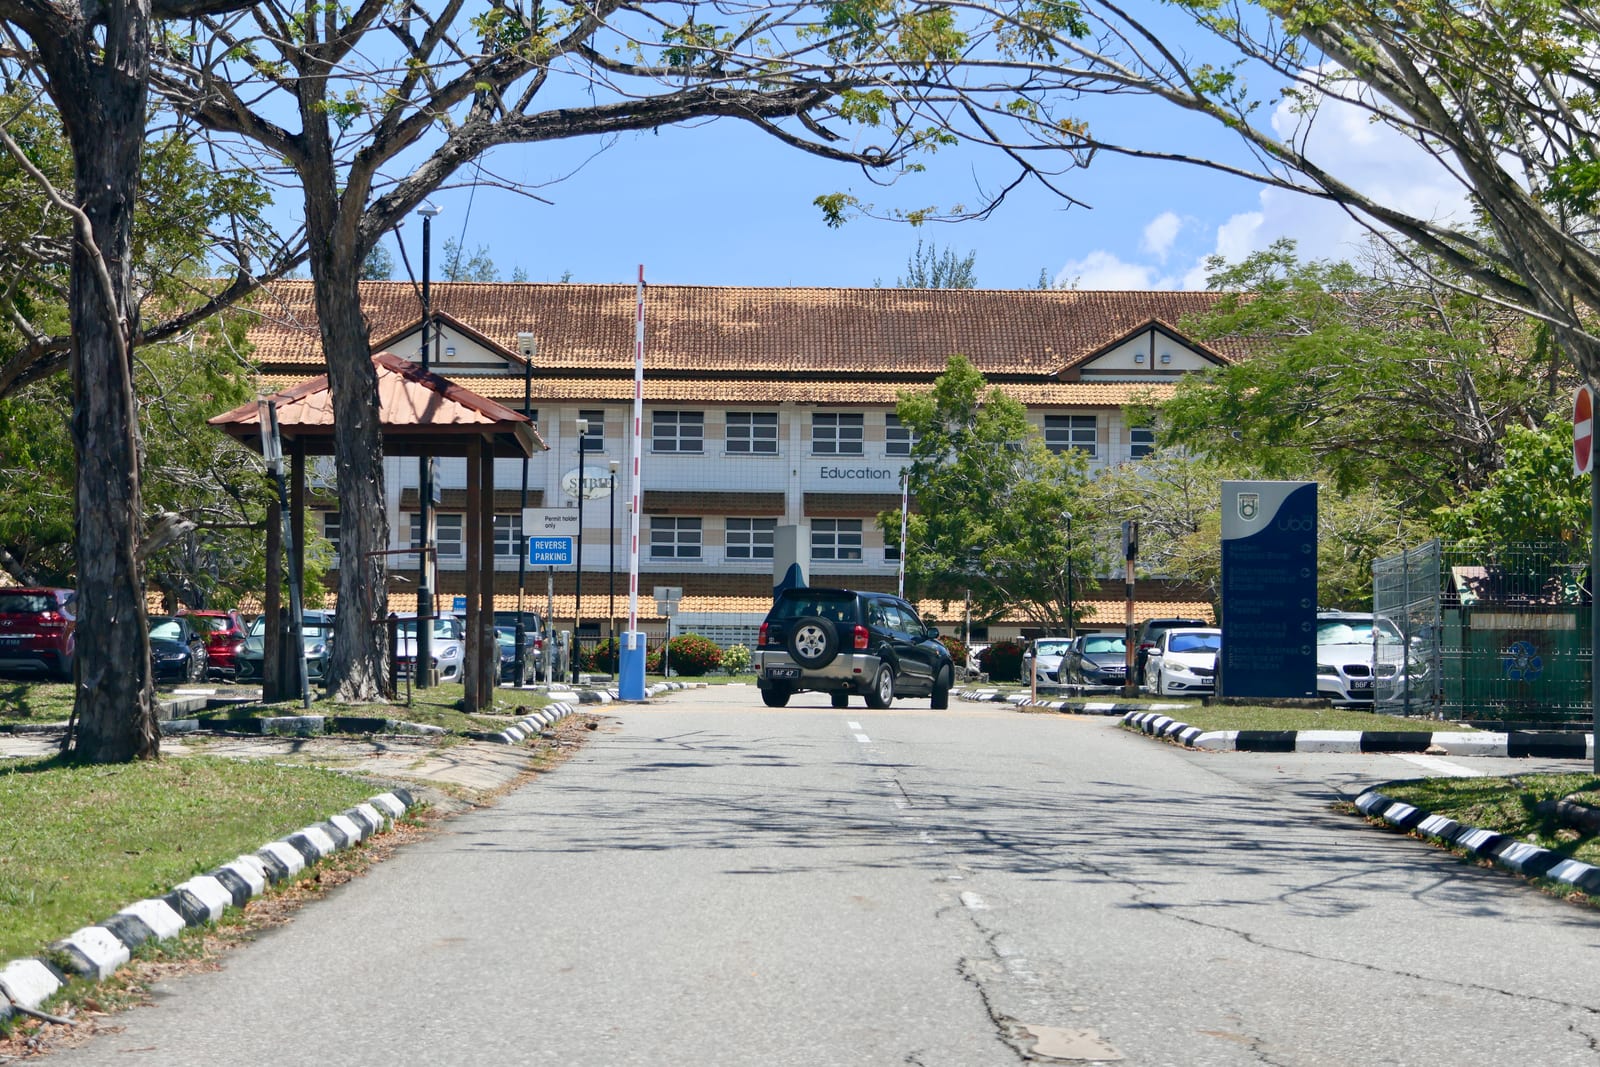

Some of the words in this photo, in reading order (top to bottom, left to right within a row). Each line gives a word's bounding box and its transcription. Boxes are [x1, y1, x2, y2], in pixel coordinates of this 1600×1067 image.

[820, 466, 891, 479] Education
[544, 522, 556, 530] only
[535, 540, 567, 550] REVERSE
[535, 552, 567, 561] PARKING
